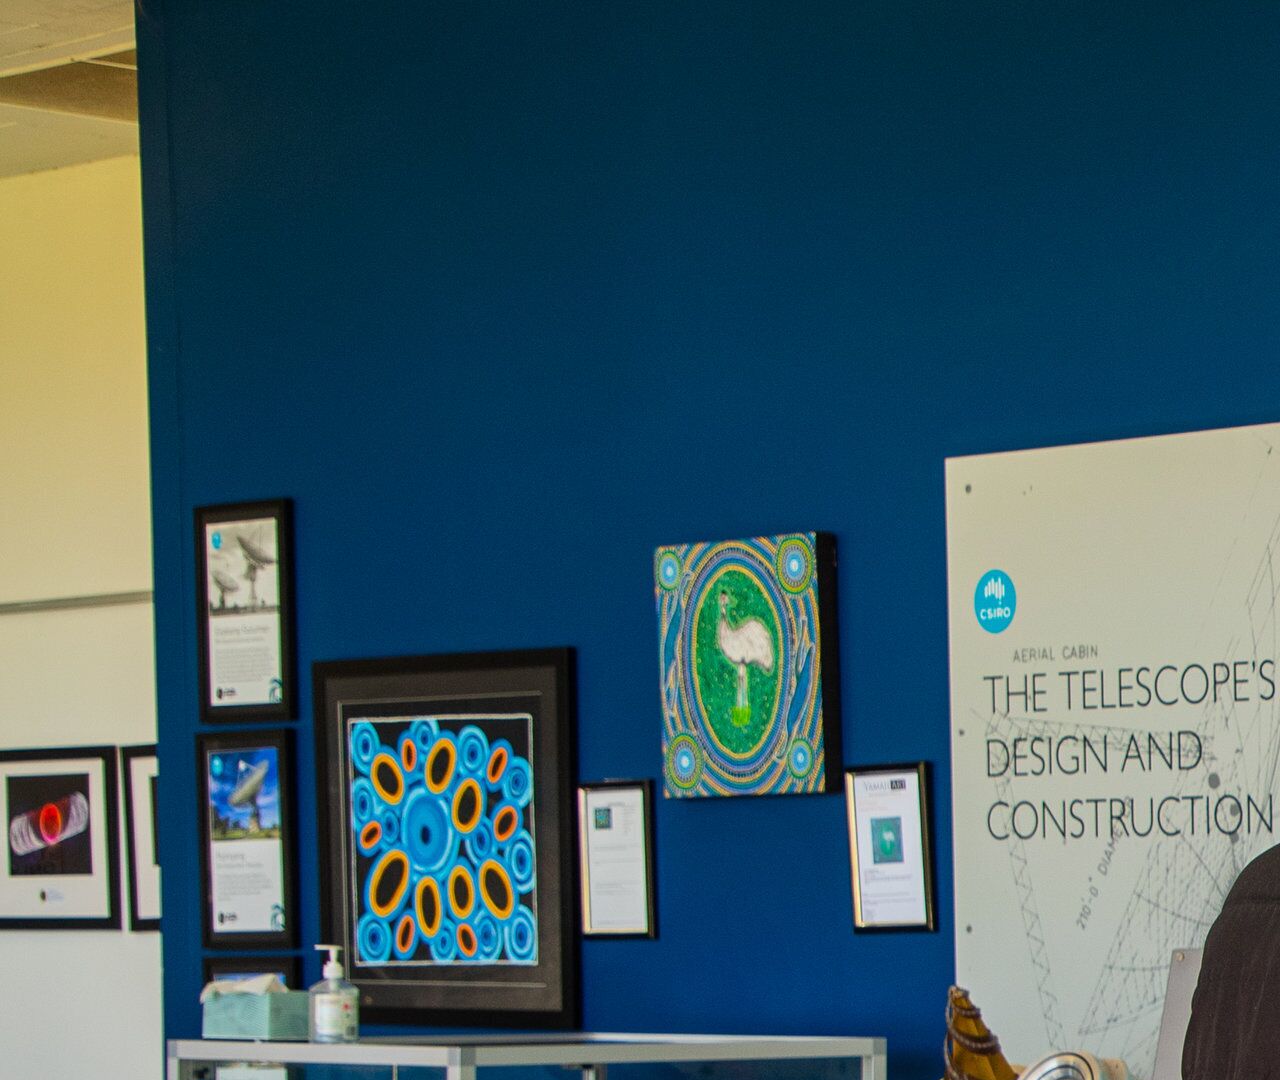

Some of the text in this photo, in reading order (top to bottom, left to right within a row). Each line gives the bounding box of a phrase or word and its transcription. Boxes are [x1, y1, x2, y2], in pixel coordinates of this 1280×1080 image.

[980, 606, 1011, 620] CSIRO
[1013, 645, 1099, 663] AERIAL CABIN
[983, 659, 1276, 714] THE TELESCOPE'S
[986, 730, 1202, 778] DESIGN AND
[987, 794, 1274, 840] CONSTRUCTION
